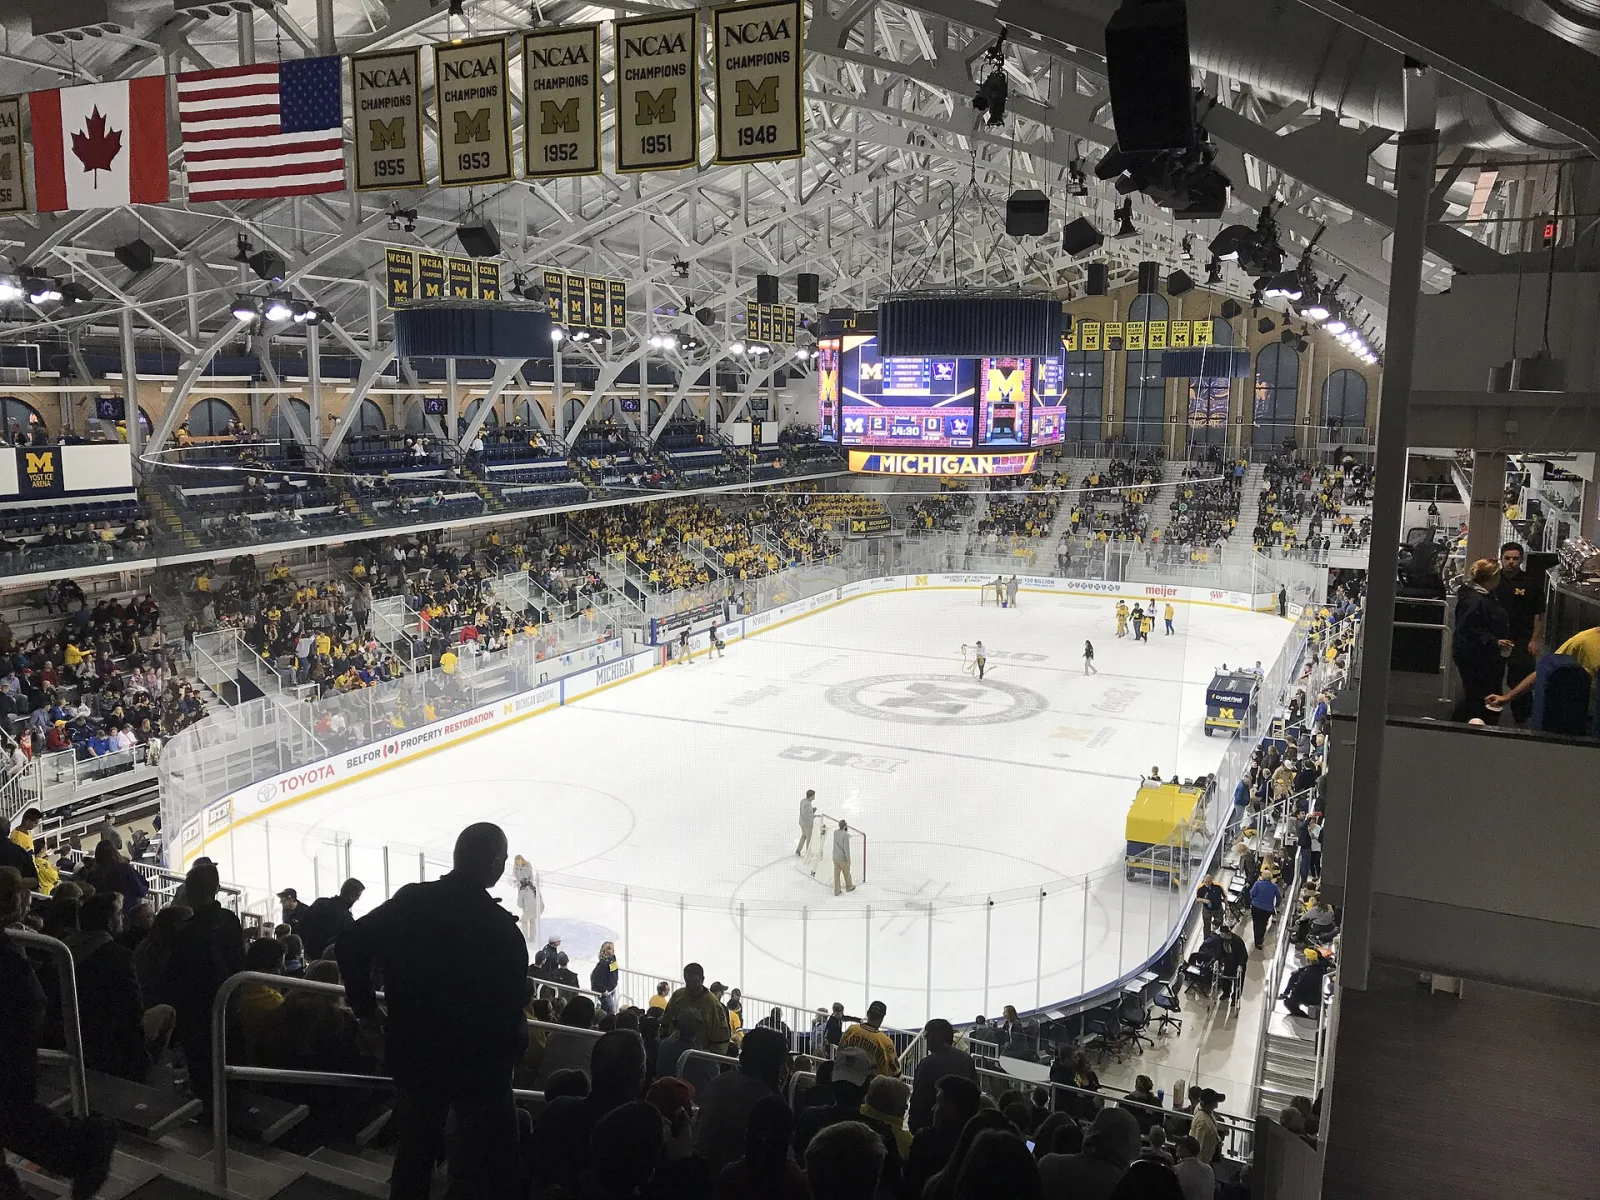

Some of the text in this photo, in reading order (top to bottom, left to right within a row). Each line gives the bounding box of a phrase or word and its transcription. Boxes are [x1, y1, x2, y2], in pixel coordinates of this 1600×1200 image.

[724, 19, 791, 47] NCAA
[624, 33, 687, 59] NCAA
[531, 45, 589, 69] NCAA
[726, 50, 790, 70] CHAMPIONS
[443, 57, 498, 82] NCAA
[625, 63, 686, 81] CHAMPIONS
[359, 68, 412, 90] NCAA
[533, 74, 589, 91] CHAMPIONS
[444, 85, 498, 102] CHAMPIONS
[735, 76, 779, 117] M
[361, 95, 412, 111] CHAMPIONS
[635, 87, 677, 125] M
[540, 98, 580, 135] M
[369, 117, 405, 151] M
[454, 108, 491, 144] M
[641, 134, 672, 154] 1951
[737, 125, 777, 146] 1948
[544, 143, 578, 162] 1952
[373, 159, 405, 177] 1955
[458, 152, 490, 171] 1953
[388, 253, 412, 265] WCHA
[420, 257, 442, 269] WCHA
[450, 262, 471, 273] WCHA
[480, 265, 497, 276] CCHA
[393, 280, 407, 294] M
[426, 283, 439, 297] M
[454, 286, 467, 300] M
[483, 288, 495, 300] M
[548, 297, 559, 310] M
[572, 300, 581, 312] M
[594, 302, 603, 314] M
[614, 304, 622, 316] M
[860, 363, 883, 380] M
[821, 369, 837, 402] M
[986, 369, 1025, 402] M
[844, 417, 864, 433] M
[873, 418, 882, 429] 2
[927, 419, 937, 430] 0
[26, 452, 54, 473] M
[880, 455, 993, 474] MICHIGAN
[852, 520, 866, 532] M
[915, 576, 928, 586] M
[1146, 586, 1177, 597] meijer
[596, 658, 635, 686] MICHIGAN
[504, 702, 512, 716] M
[1220, 708, 1234, 718] M
[346, 710, 494, 769] BELFOR PROPERTY RESTORATION
[279, 764, 335, 793] TOYOTA
